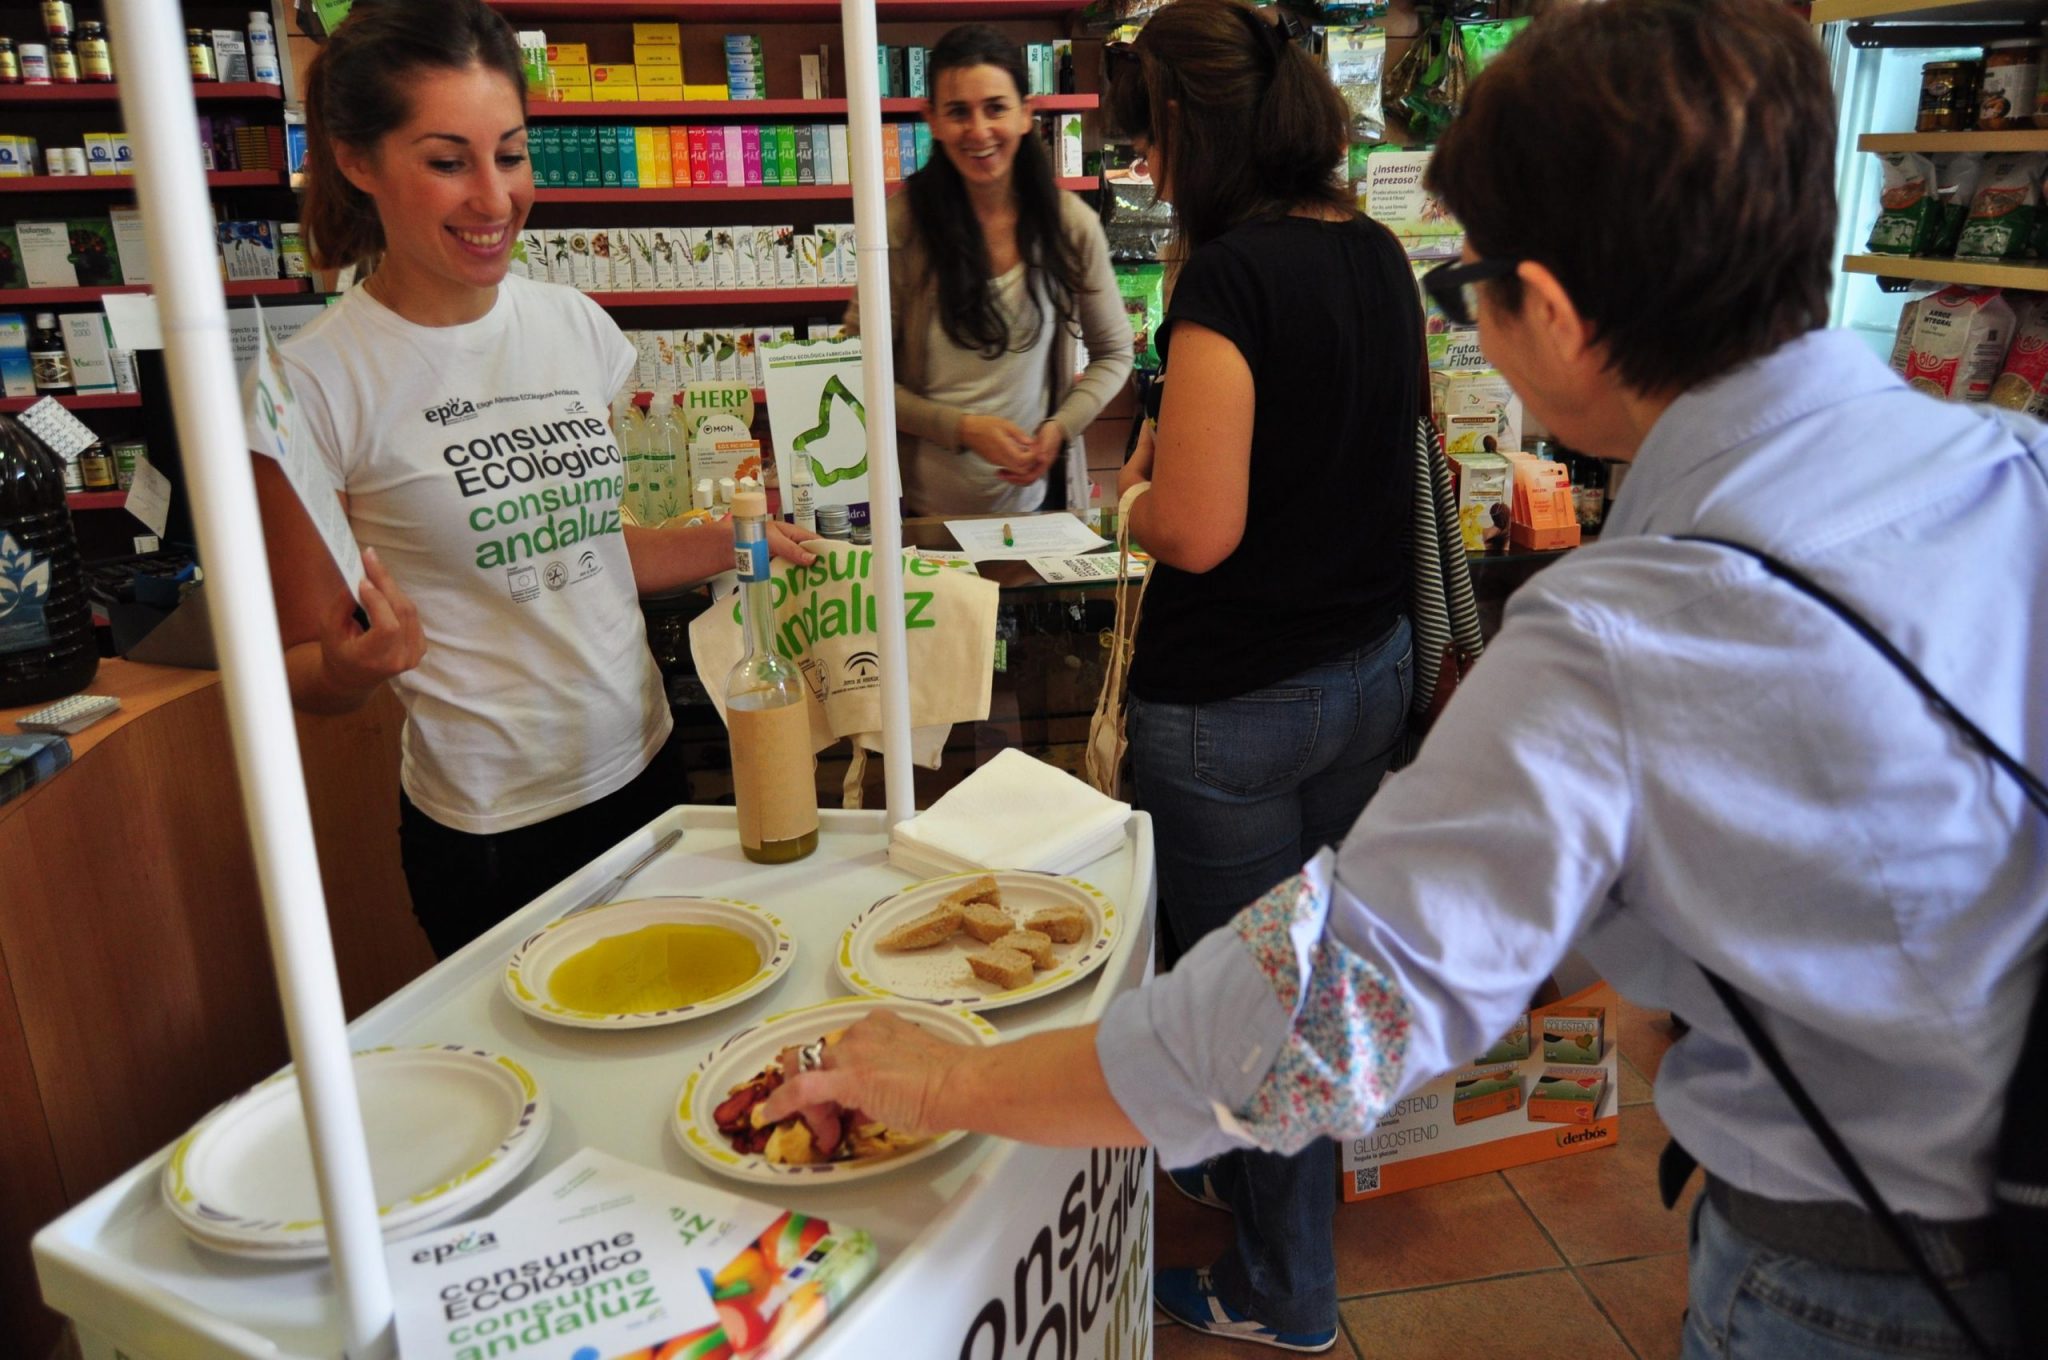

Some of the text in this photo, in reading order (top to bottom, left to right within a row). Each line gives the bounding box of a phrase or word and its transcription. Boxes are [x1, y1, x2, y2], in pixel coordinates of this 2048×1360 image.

[1373, 164, 1421, 175] ¿Instestino
[1373, 175, 1418, 187] perezoso?
[1445, 343, 1481, 355] Frutas
[1449, 355, 1487, 367] Fibras
[690, 389, 749, 408] HERP
[443, 417, 605, 467] consume
[713, 424, 734, 432] MON
[455, 443, 620, 497] ECOlógico
[469, 474, 623, 532] consume
[475, 506, 622, 569] andaluz
[1353, 1124, 1439, 1155] GLUCOSTEND
[1563, 1127, 1607, 1147] derbós
[439, 1229, 636, 1303] consume
[442, 1247, 643, 1322] ECOlógico
[447, 1264, 651, 1347] consume
[453, 1285, 661, 1360] andaluz
